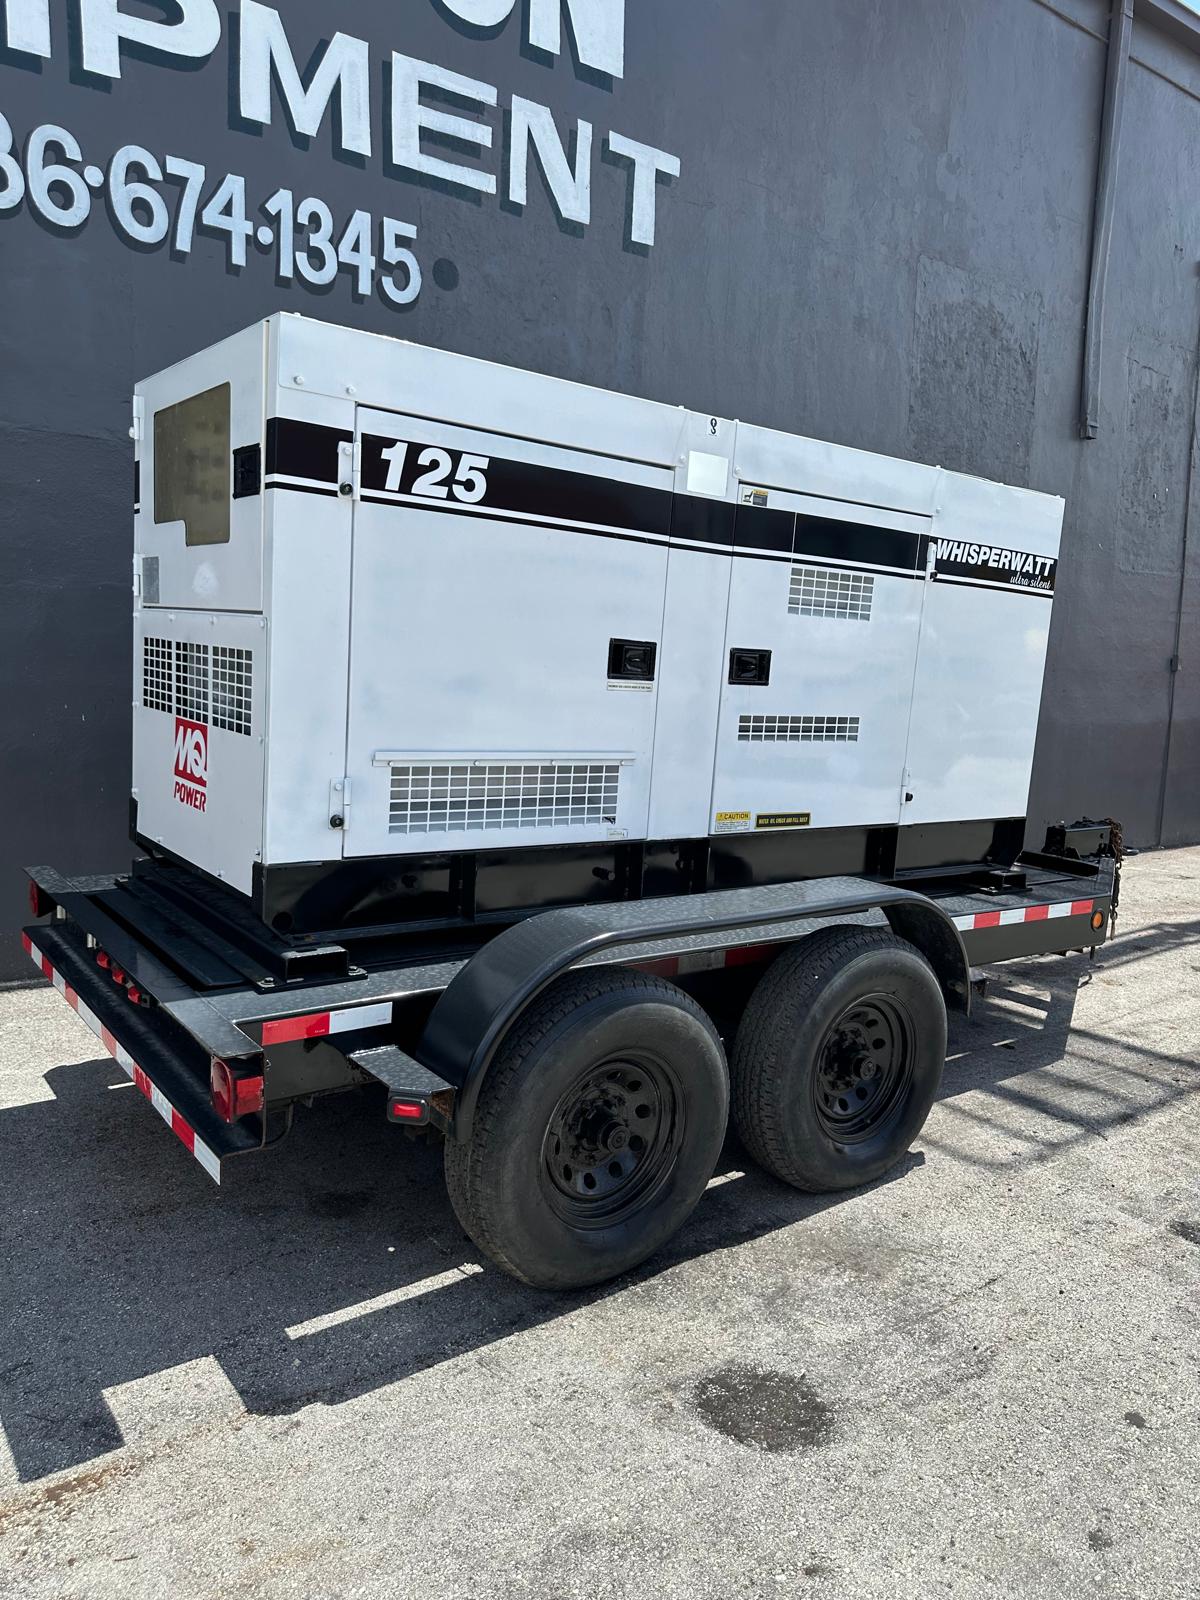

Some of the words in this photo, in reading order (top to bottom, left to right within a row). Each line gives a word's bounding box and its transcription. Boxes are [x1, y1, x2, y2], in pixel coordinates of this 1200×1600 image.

[380, 441, 490, 504] 125
[935, 538, 1055, 577] WHISPERWATT
[1010, 572, 1030, 586] ultra
[1030, 574, 1052, 590] silent
[173, 725, 208, 781] MQ
[173, 781, 207, 812] POWER
[723, 812, 749, 820] CAUTION
